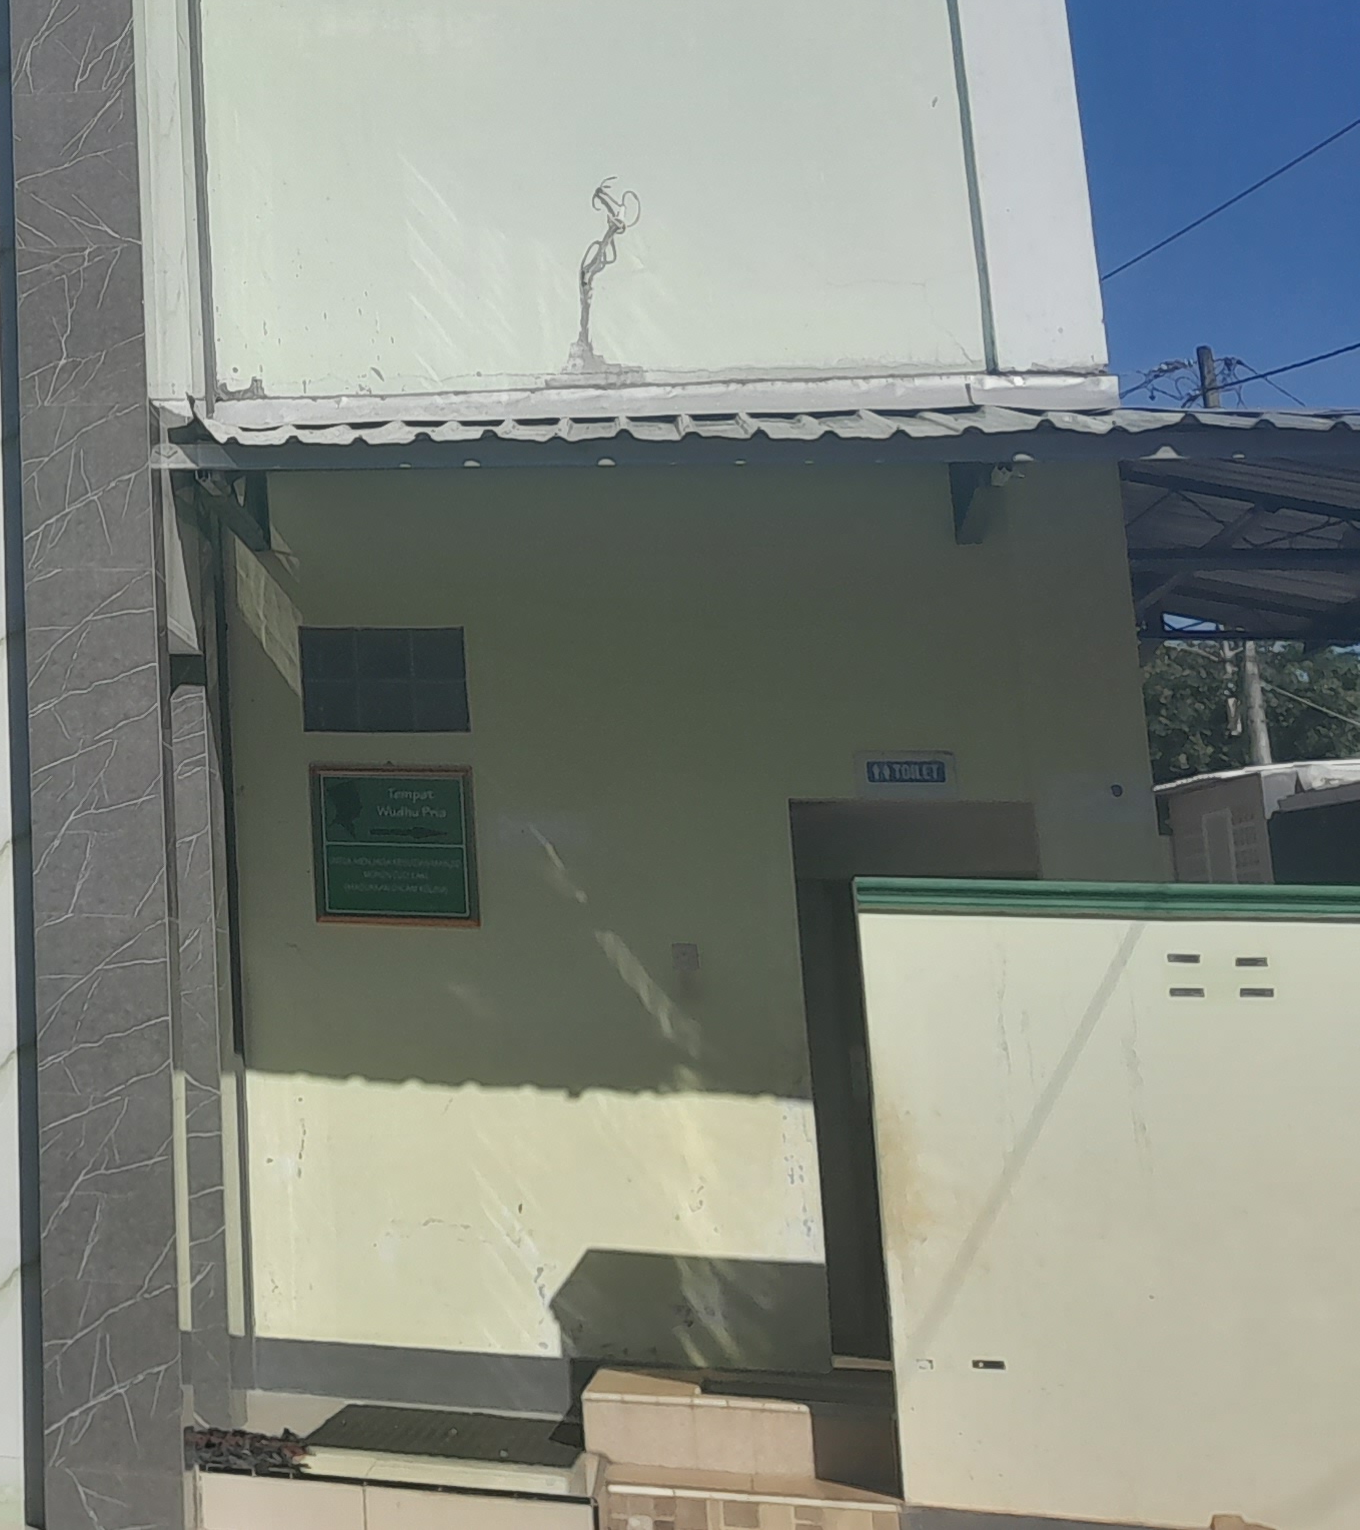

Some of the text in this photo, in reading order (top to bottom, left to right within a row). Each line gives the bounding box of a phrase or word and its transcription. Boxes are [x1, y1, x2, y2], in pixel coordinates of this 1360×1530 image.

[892, 764, 939, 780] TOILET
[387, 787, 435, 804] Tempat
[376, 805, 447, 818] Wudhu Pria
